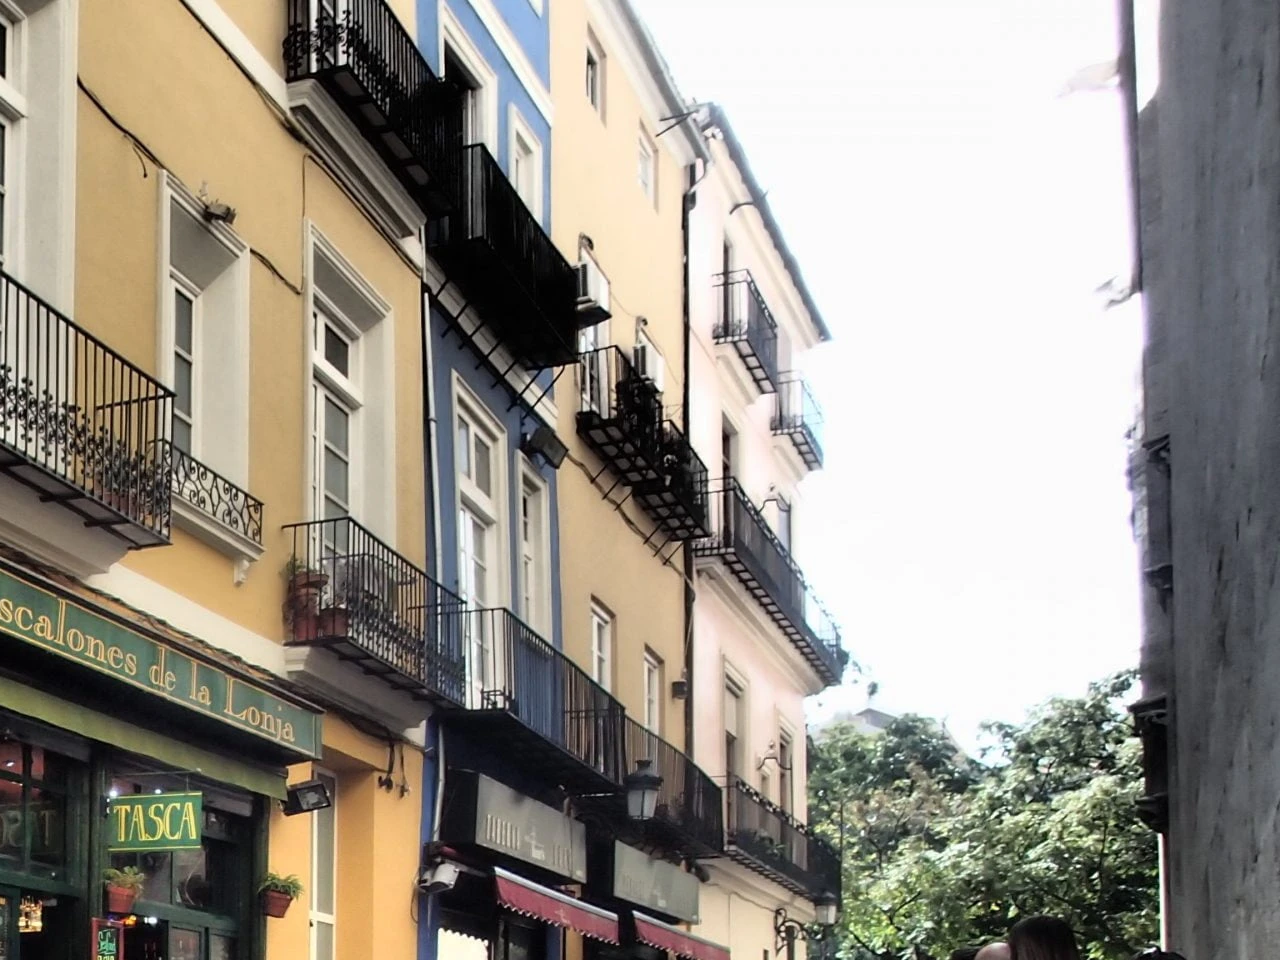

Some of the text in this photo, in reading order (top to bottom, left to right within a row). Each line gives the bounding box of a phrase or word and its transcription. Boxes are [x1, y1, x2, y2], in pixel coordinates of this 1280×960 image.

[149, 646, 177, 690] de
[189, 660, 212, 706] la
[223, 677, 296, 743] Lonja
[114, 801, 197, 841] TASCA
